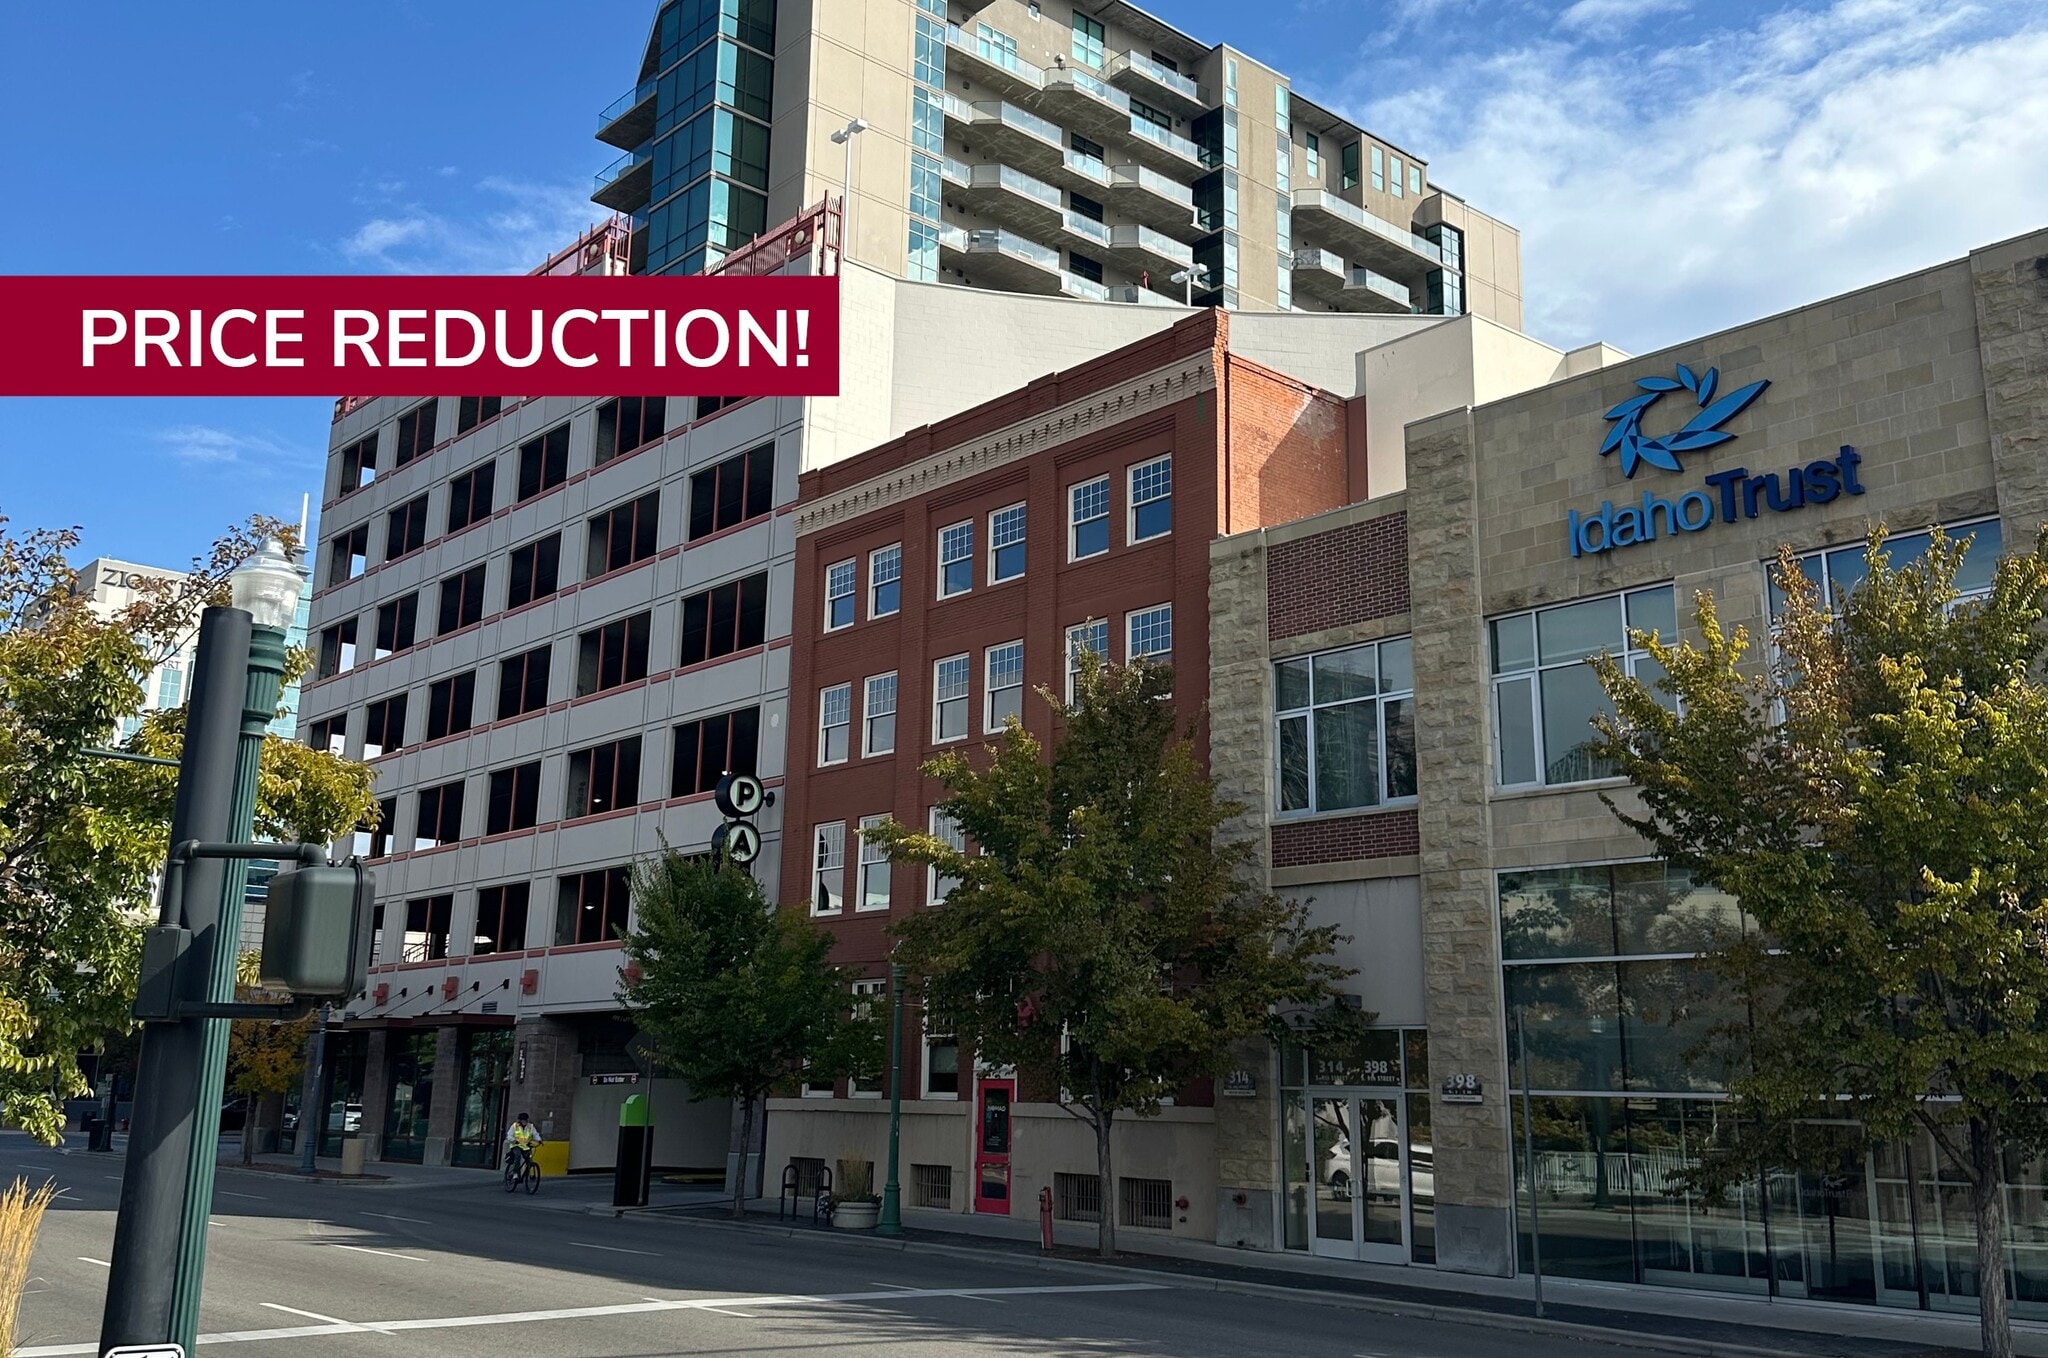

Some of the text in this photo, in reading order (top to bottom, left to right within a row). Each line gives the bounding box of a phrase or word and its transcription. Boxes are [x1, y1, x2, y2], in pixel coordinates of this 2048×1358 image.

[1319, 1060, 1345, 1074] 314
[1364, 1060, 1388, 1074] 398
[1229, 1070, 1249, 1084] 314
[1446, 1074, 1476, 1089] 398
